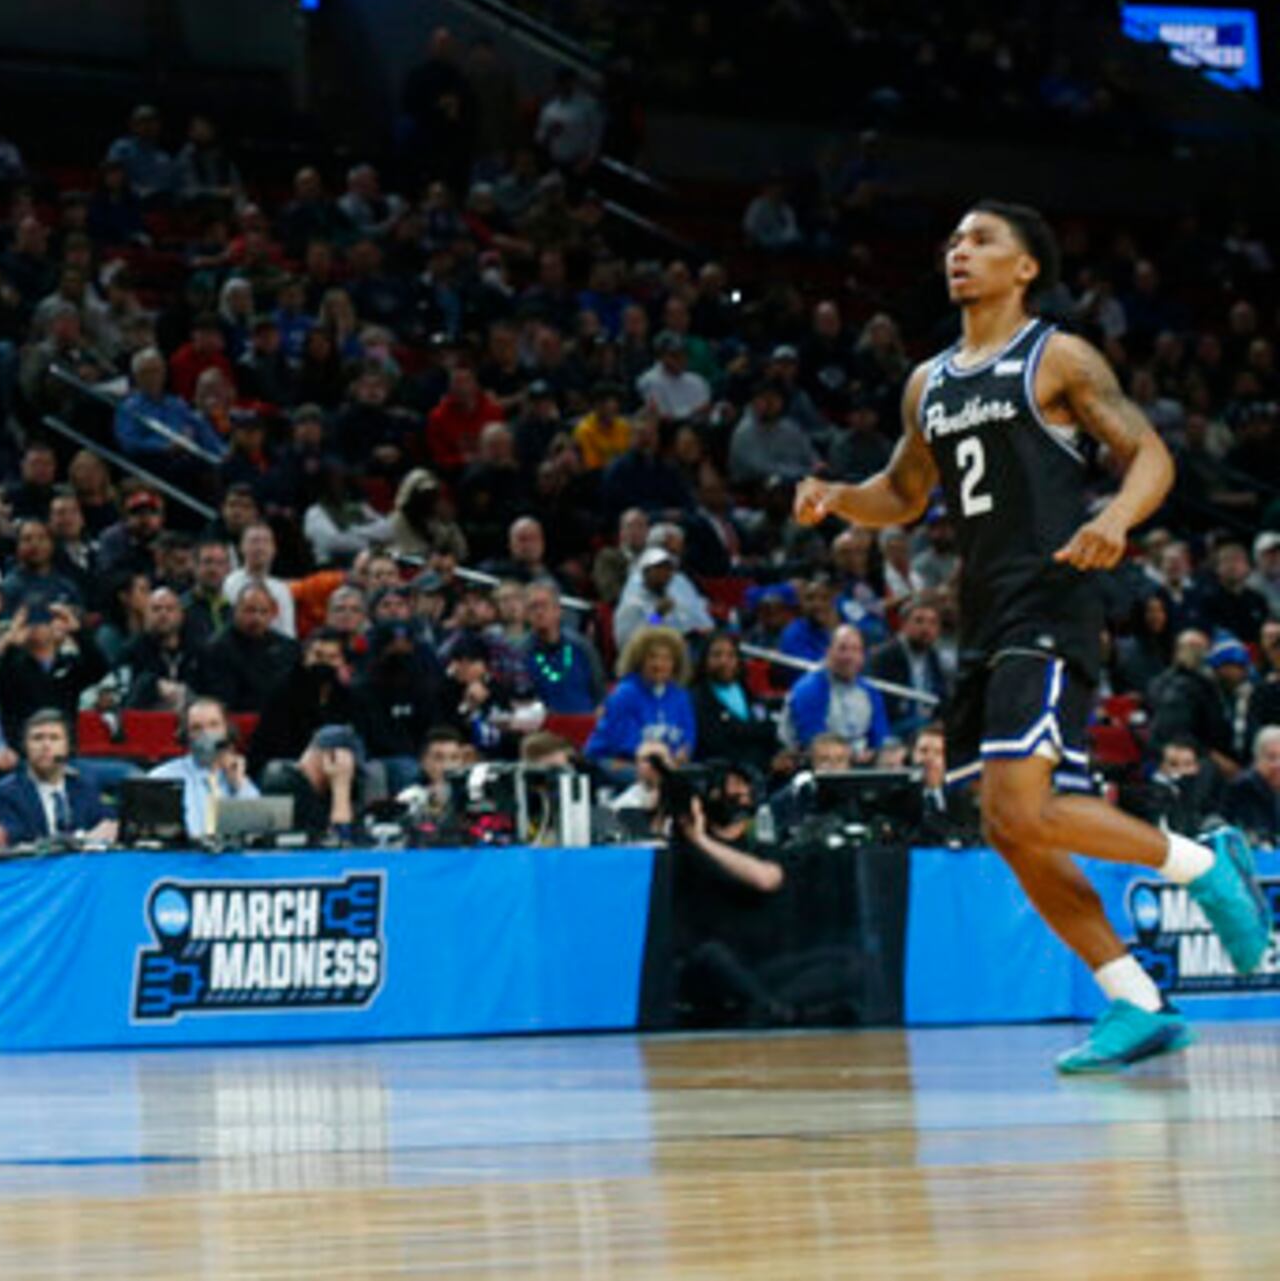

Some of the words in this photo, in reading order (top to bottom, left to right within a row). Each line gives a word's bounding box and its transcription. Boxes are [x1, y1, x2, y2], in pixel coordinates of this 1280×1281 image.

[956, 436, 993, 517] 2
[191, 889, 321, 939] MARCH
[209, 938, 379, 990] MADNESS
